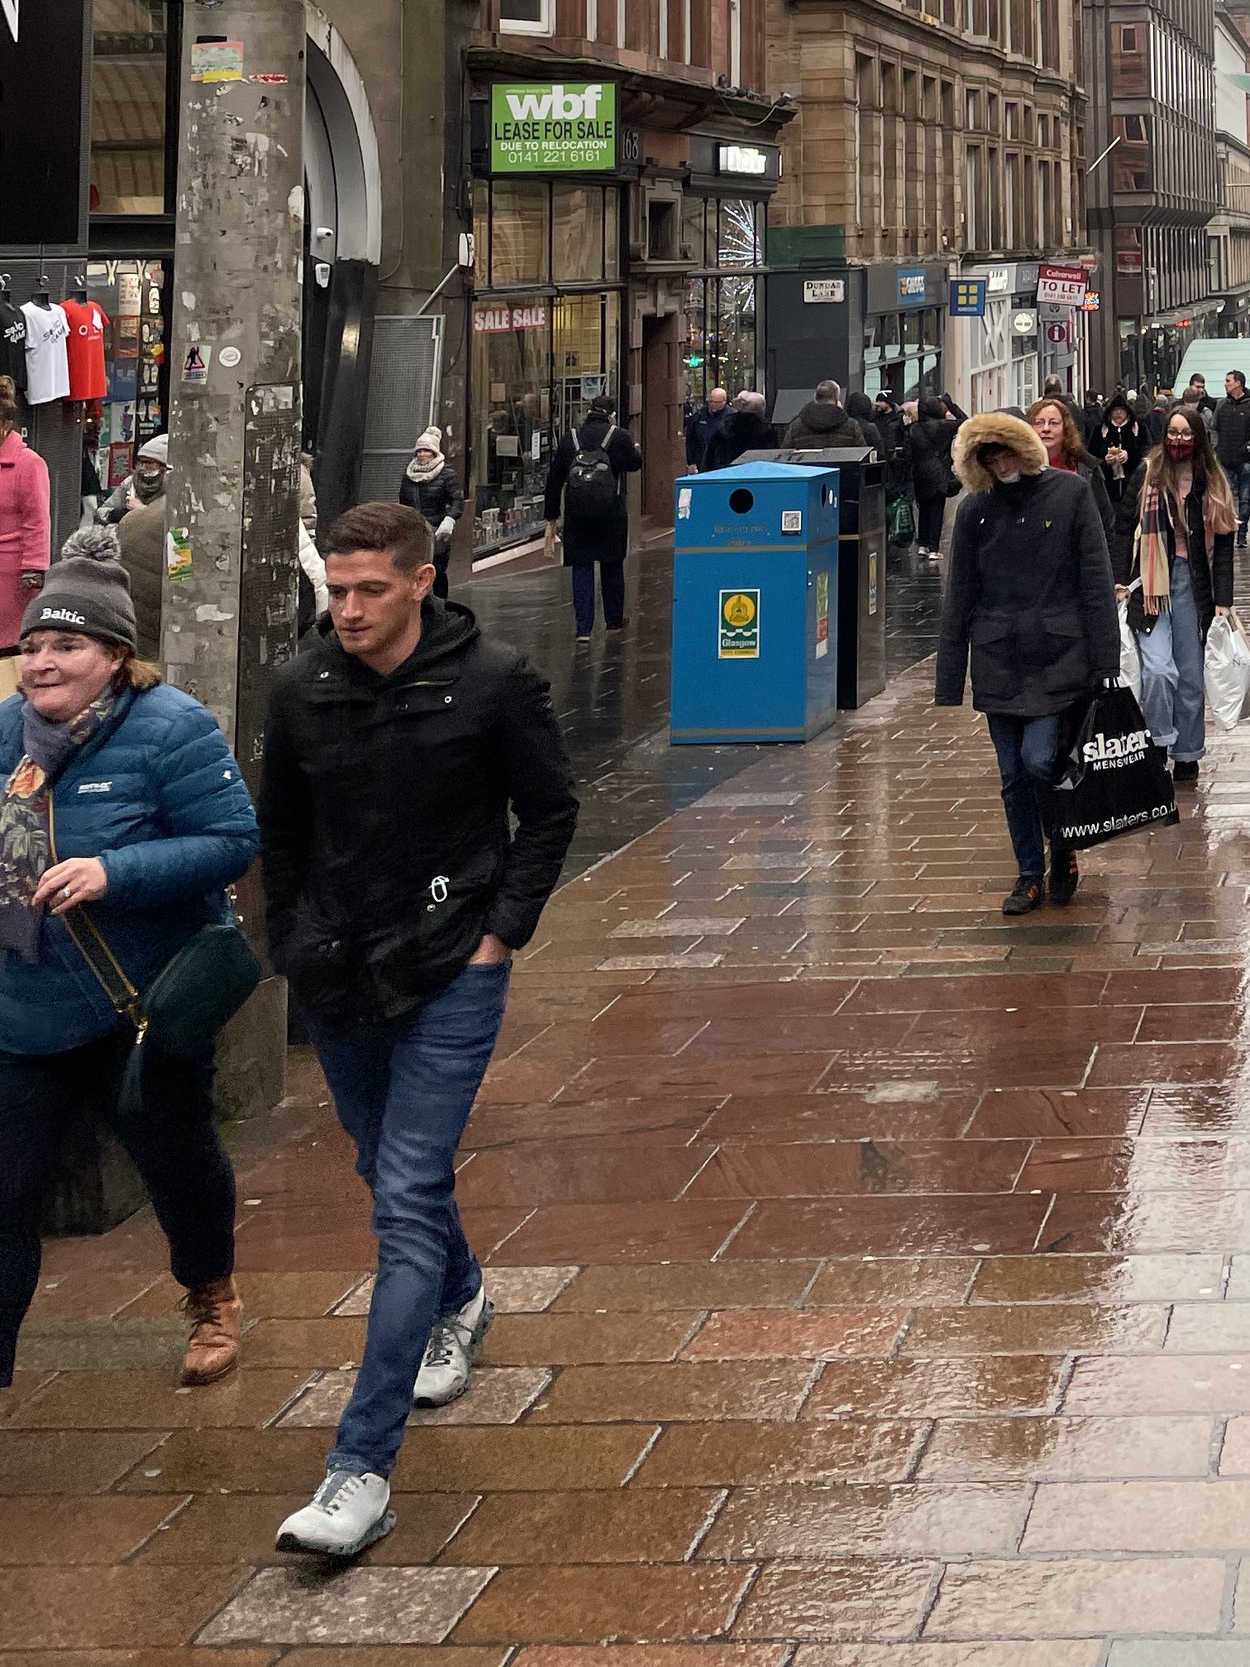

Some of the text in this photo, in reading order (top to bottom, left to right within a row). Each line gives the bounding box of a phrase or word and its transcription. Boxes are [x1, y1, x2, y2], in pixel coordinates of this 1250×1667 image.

[505, 84, 602, 121] wbf
[494, 120, 613, 141] LEASE FOR SALE
[500, 140, 607, 151] DUE TO RELOCATION
[508, 150, 600, 163] 0141 221 6161
[1042, 281, 1083, 294] TO LET
[474, 307, 545, 331] SALE SALE
[40, 608, 85, 624] Baltic
[722, 638, 755, 649] Glasgow
[1082, 729, 1151, 763] slater
[1093, 750, 1145, 771] MENSWEAR
